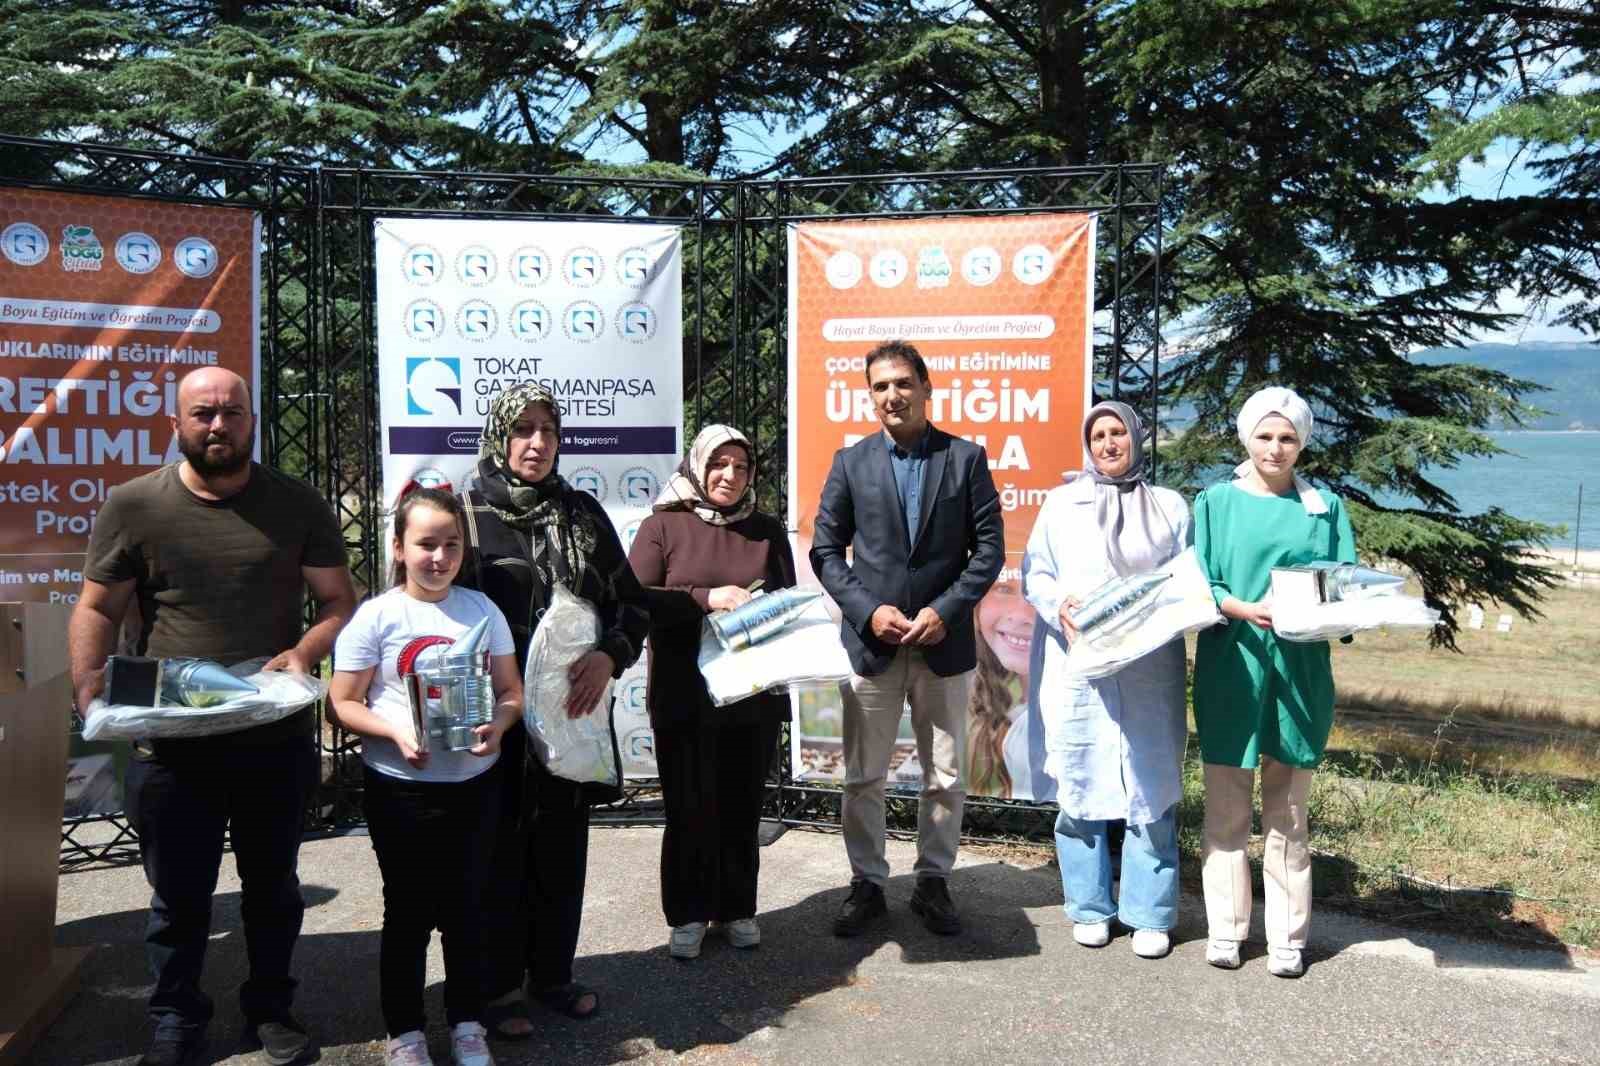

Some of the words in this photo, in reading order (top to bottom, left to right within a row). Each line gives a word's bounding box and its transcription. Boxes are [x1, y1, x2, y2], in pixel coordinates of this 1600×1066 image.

[2, 304, 38, 319] Boyu
[91, 311, 105, 321] ve
[164, 313, 209, 327] Projesi
[833, 325, 865, 337] Hayat
[868, 325, 896, 337] Boyu
[937, 326, 951, 334] ve
[1003, 321, 1042, 335] Projesi
[118, 343, 219, 366] EĞİTİMİNE
[959, 351, 1052, 371] EĞİTİMİNE
[473, 357, 543, 375] TOKAT
[474, 376, 656, 399] GASMANPAŞA
[825, 378, 1050, 423] ÜRTİĞİM
[27, 573, 50, 584] ve
